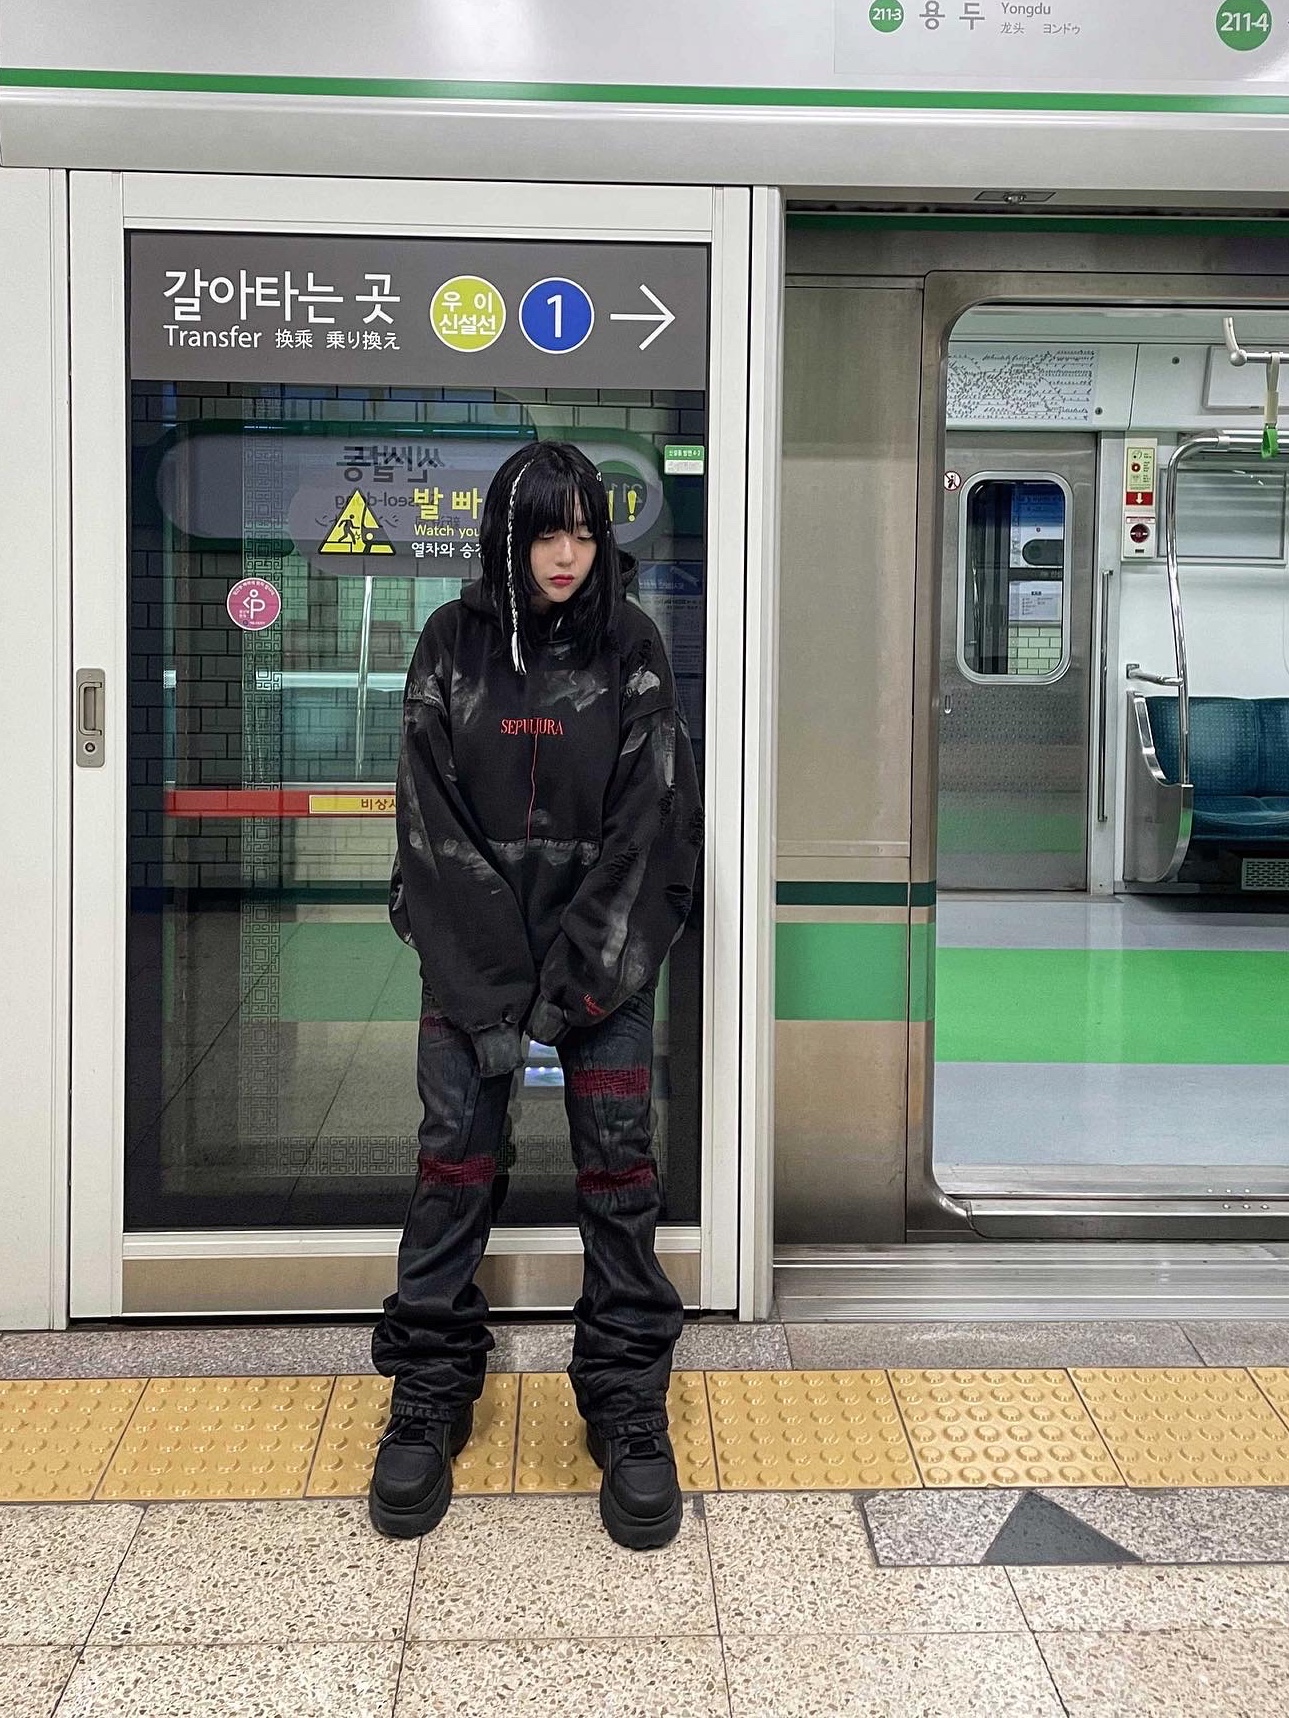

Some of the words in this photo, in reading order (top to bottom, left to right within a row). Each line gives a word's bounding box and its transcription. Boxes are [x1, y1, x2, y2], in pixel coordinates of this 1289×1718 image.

[872, 8, 901, 21] 211-3
[1001, 2, 1051, 18] Yongdu
[1000, 22, 1025, 35] 龙头
[1220, 11, 1269, 32] 211-4
[163, 268, 344, 324] 갈아타는
[355, 273, 401, 325] 곳
[439, 313, 496, 335] 신설선
[546, 294, 563, 338] 1
[163, 324, 262, 348] Transfer
[275, 328, 314, 349] 换乘
[326, 330, 401, 350] 乗り換え
[413, 487, 444, 520] 발
[413, 523, 454, 537] Watch
[411, 541, 455, 558] 열차와
